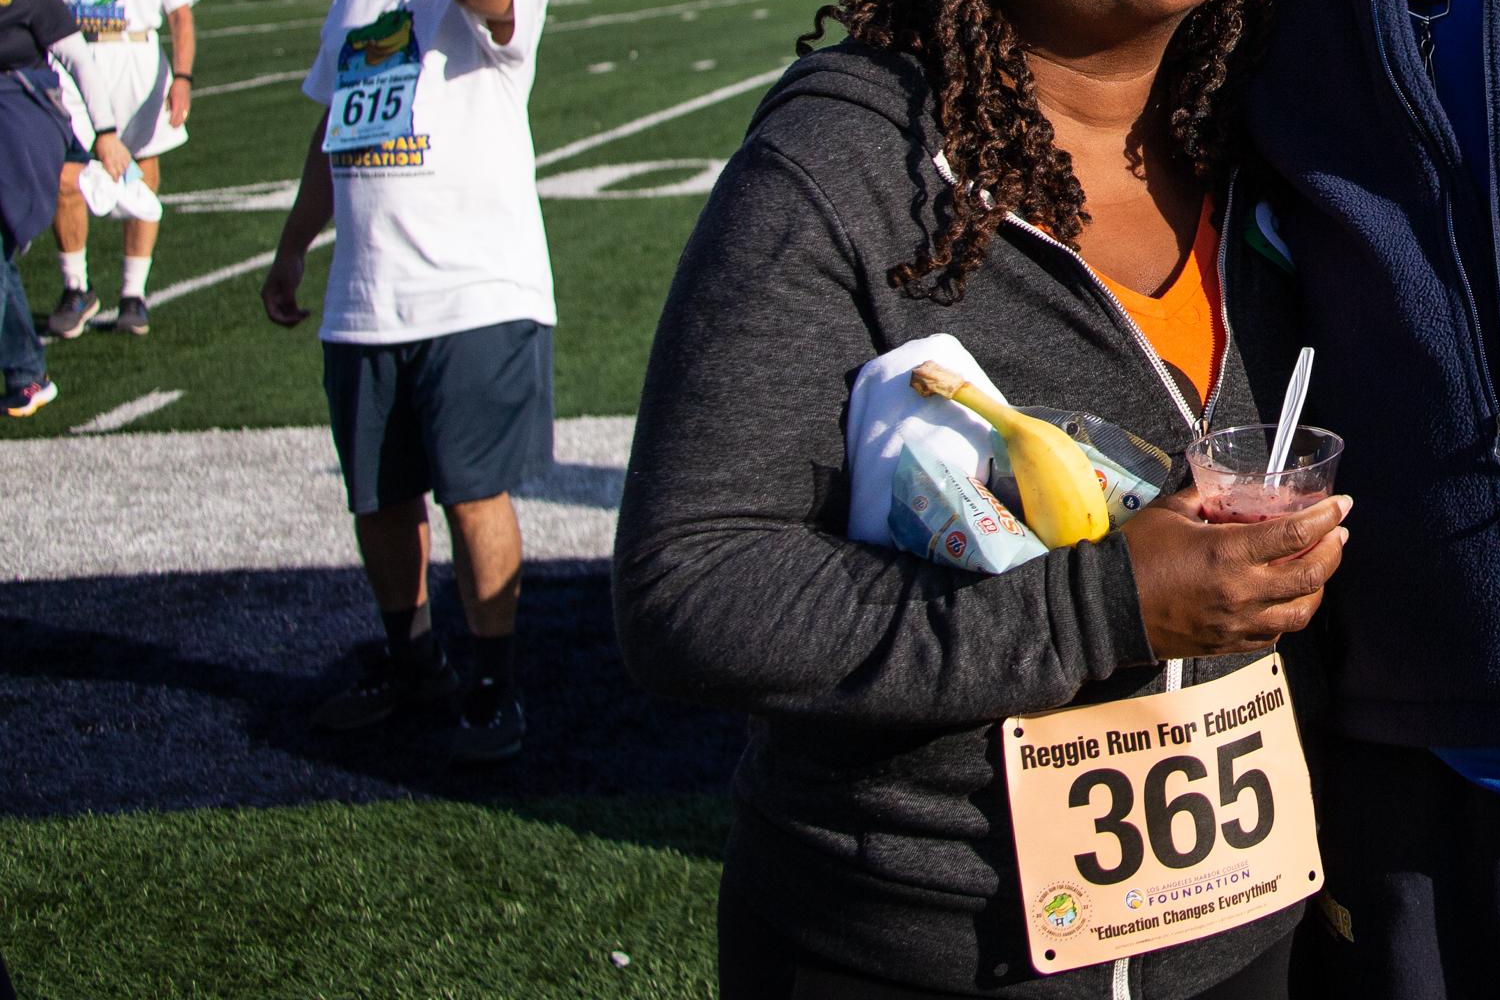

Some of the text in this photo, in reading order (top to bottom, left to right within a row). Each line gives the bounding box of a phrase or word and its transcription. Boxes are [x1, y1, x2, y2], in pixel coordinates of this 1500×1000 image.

[342, 85, 405, 126] 615
[381, 134, 430, 150] WALK
[947, 535, 965, 555] 76
[1020, 686, 1285, 770] Reggie Run For Education
[1068, 731, 1275, 885] 365
[1148, 869, 1250, 907] FOUNDATION
[1162, 878, 1193, 890] ANGELES
[1194, 870, 1220, 883] HARBOR
[1222, 860, 1249, 876] COLLEGE
[1163, 901, 1215, 925] Changes
